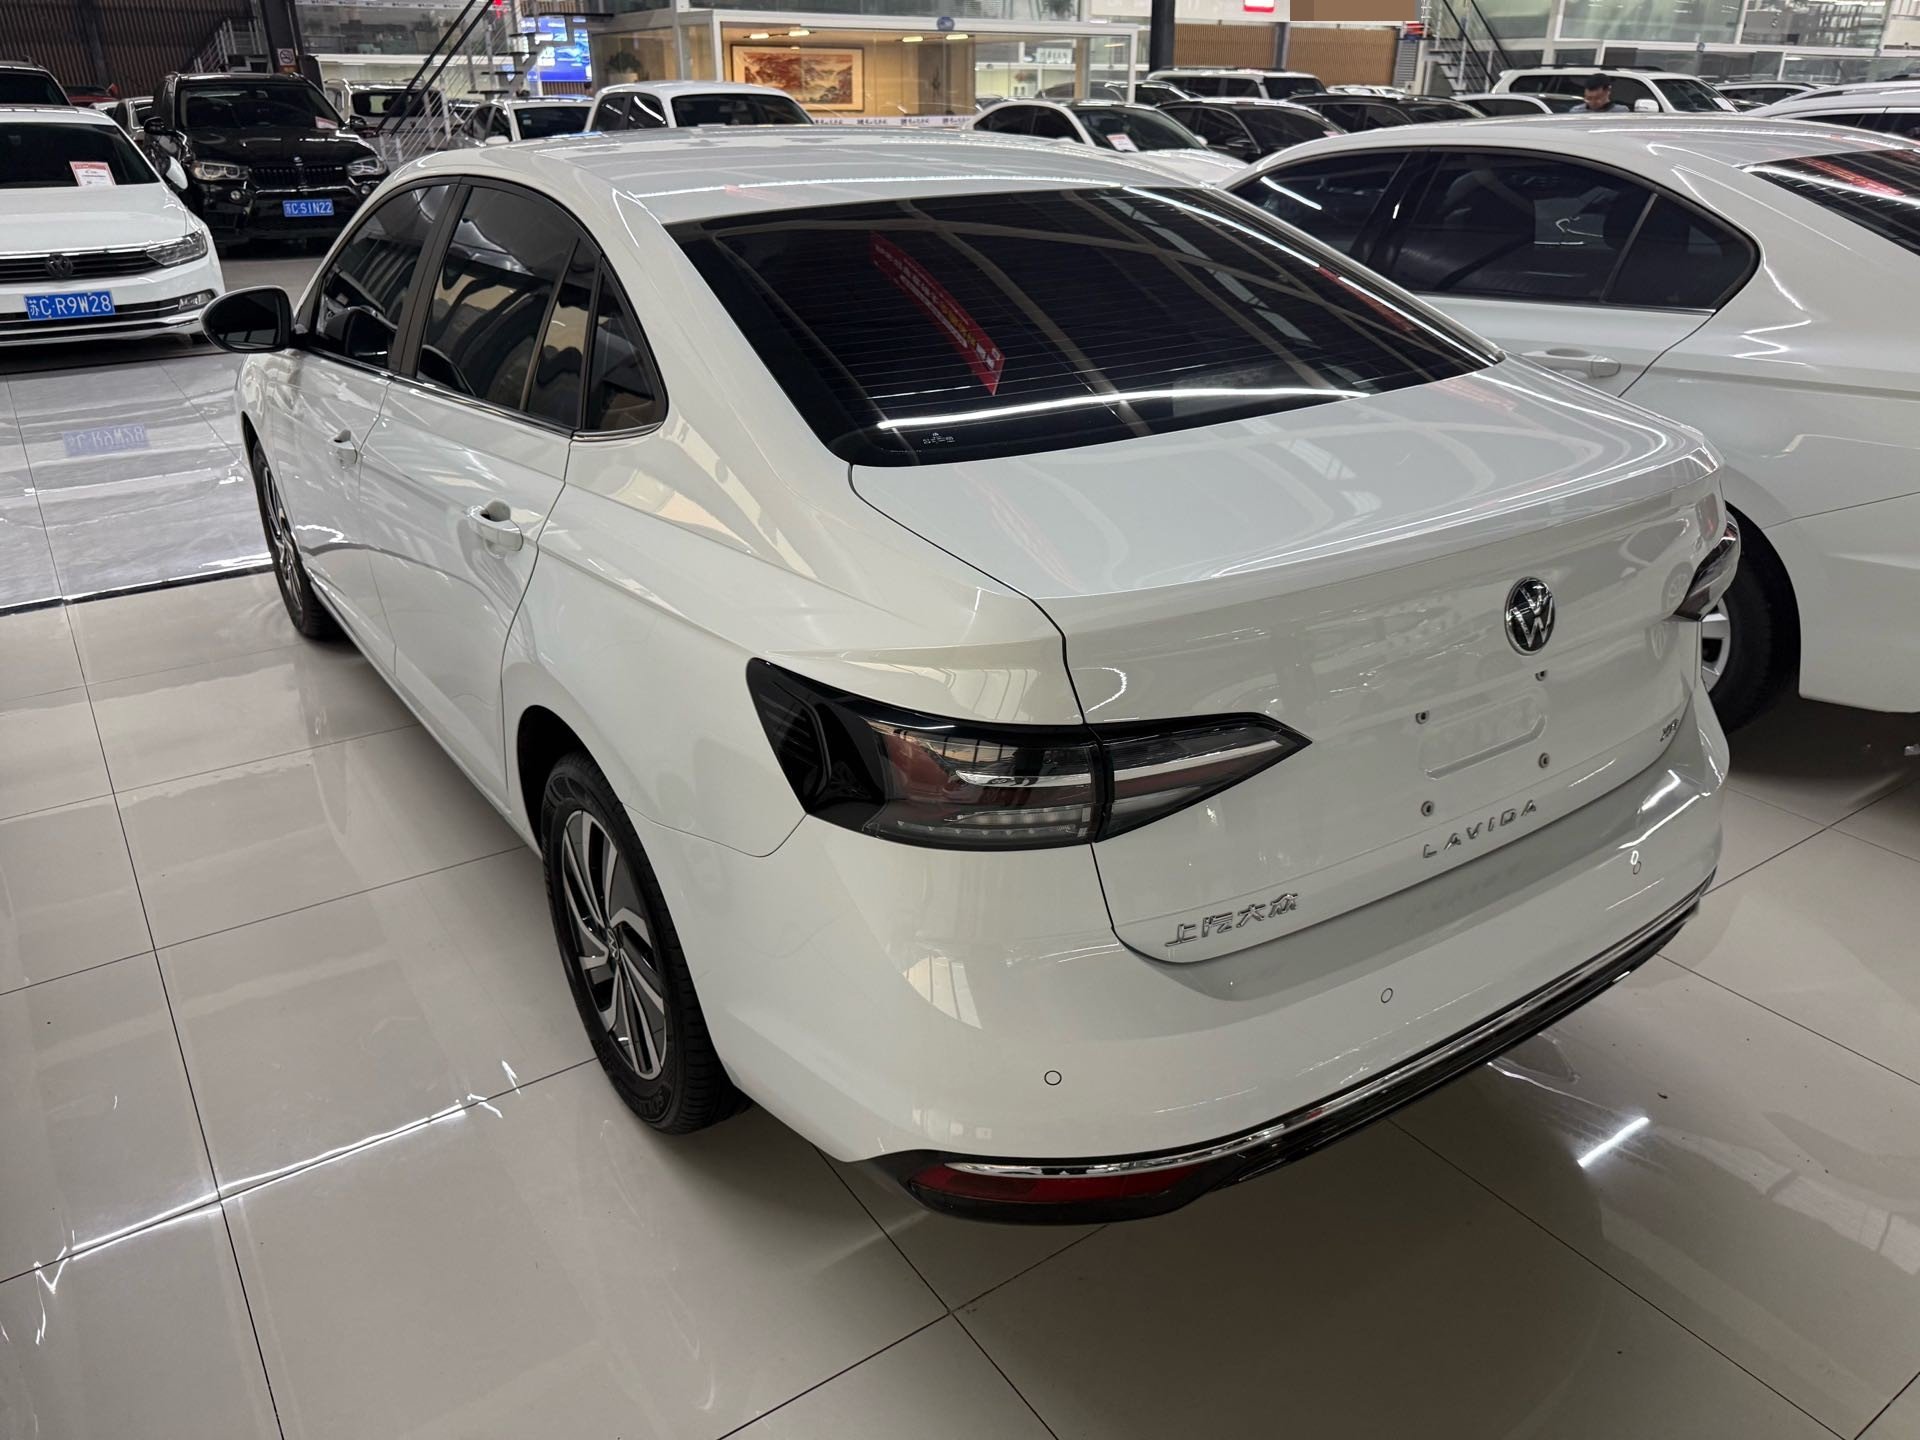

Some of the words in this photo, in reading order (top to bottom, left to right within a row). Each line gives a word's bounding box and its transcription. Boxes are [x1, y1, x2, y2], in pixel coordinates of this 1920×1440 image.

[1423, 800, 1537, 858] LAVIDA
[1164, 893, 1298, 947] 上汽大众
